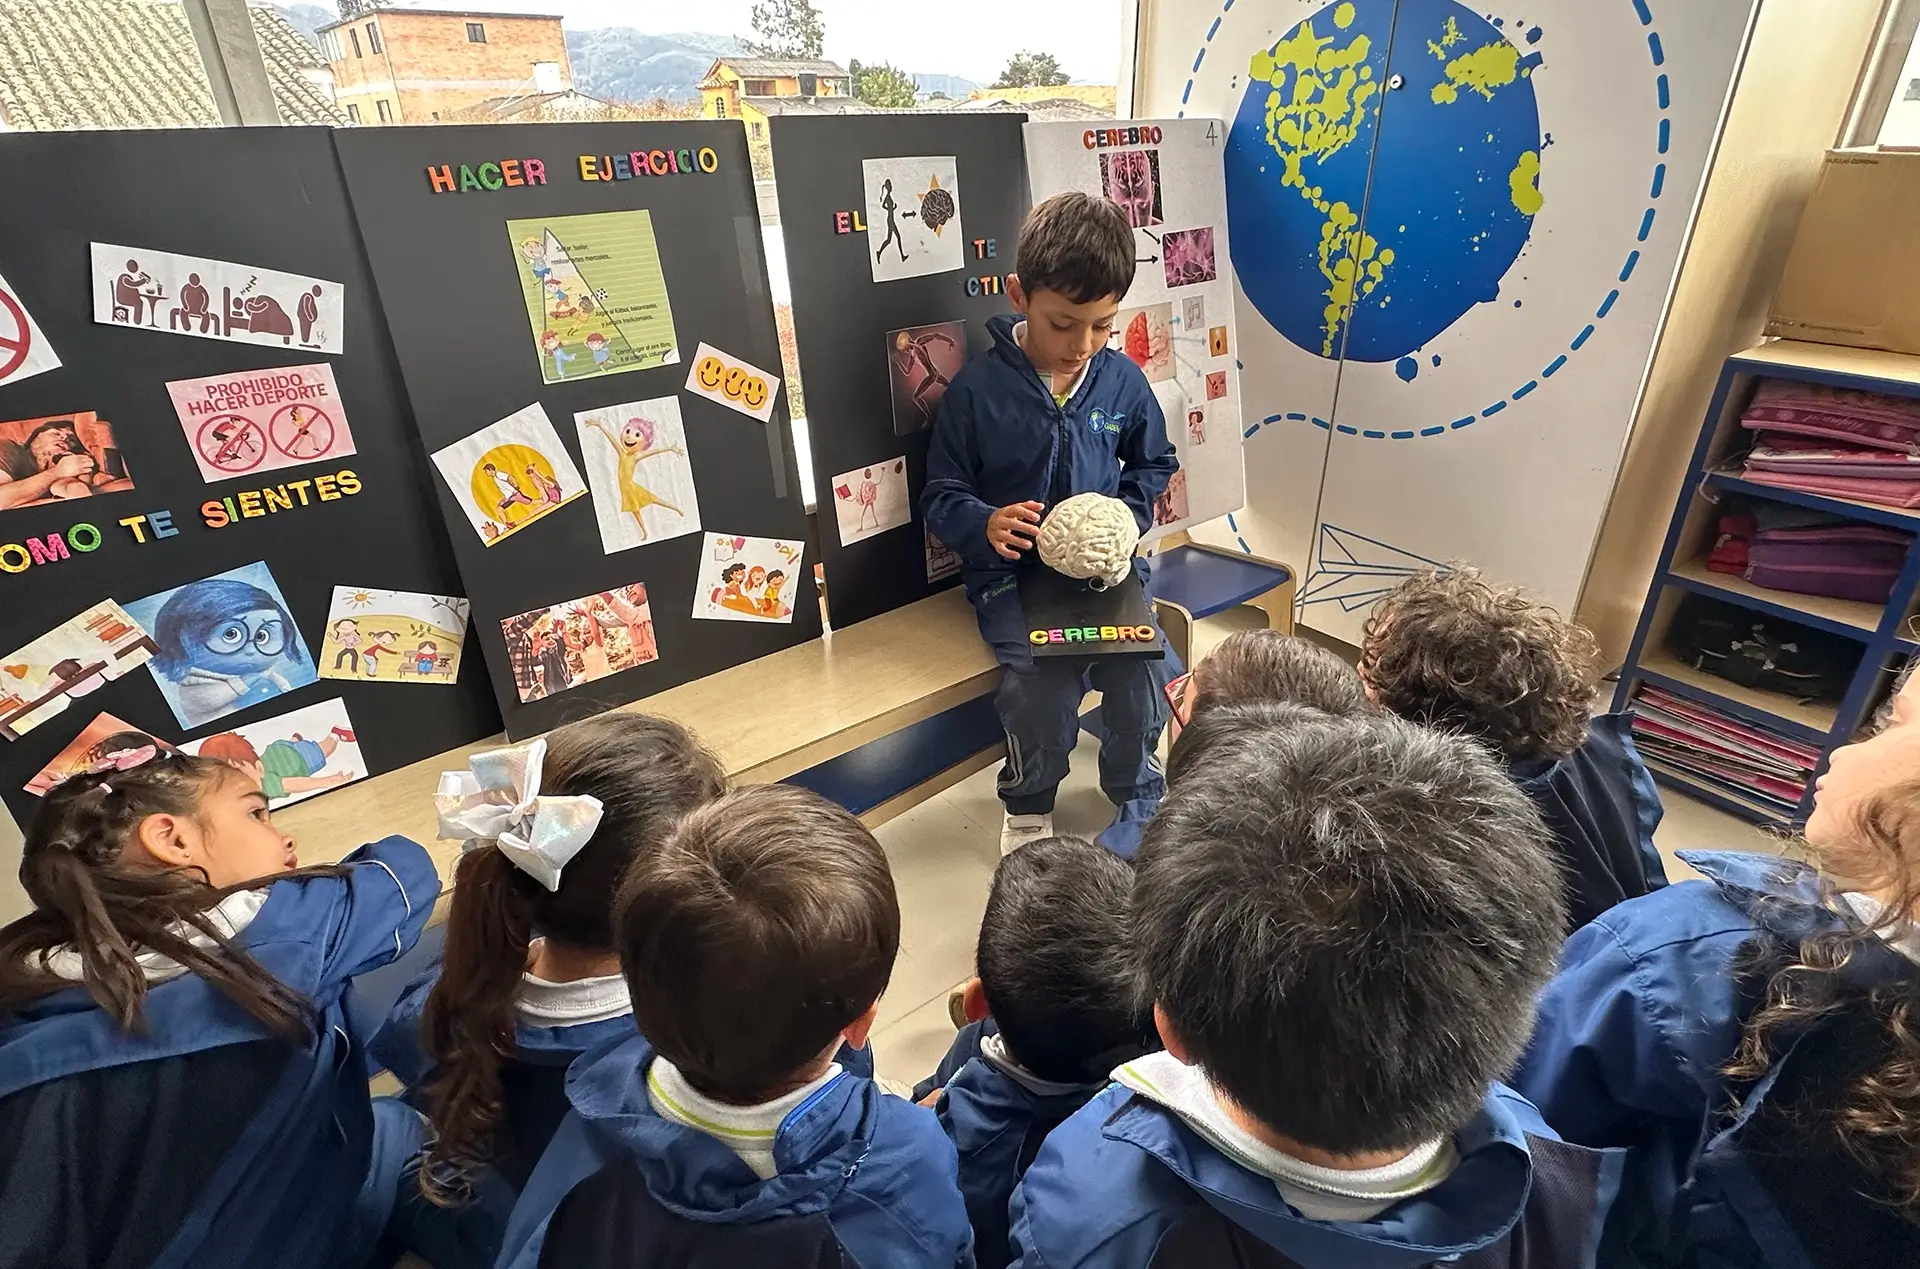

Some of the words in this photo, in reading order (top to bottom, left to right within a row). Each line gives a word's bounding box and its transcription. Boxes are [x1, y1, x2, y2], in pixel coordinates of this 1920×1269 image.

[1083, 126, 1163, 149] CEREBRO
[1206, 121, 1218, 146] 4
[427, 159, 547, 193] HACER
[579, 147, 719, 181] EJERCICIO
[835, 210, 867, 233] EL
[973, 238, 997, 259] TE
[206, 373, 302, 399] PROHIBIDO
[187, 394, 250, 415] HACER
[252, 383, 328, 406] DEPORTE
[119, 510, 180, 543] TE
[201, 470, 362, 528] SIENTES
[1029, 625, 1156, 645] CEREBRO
